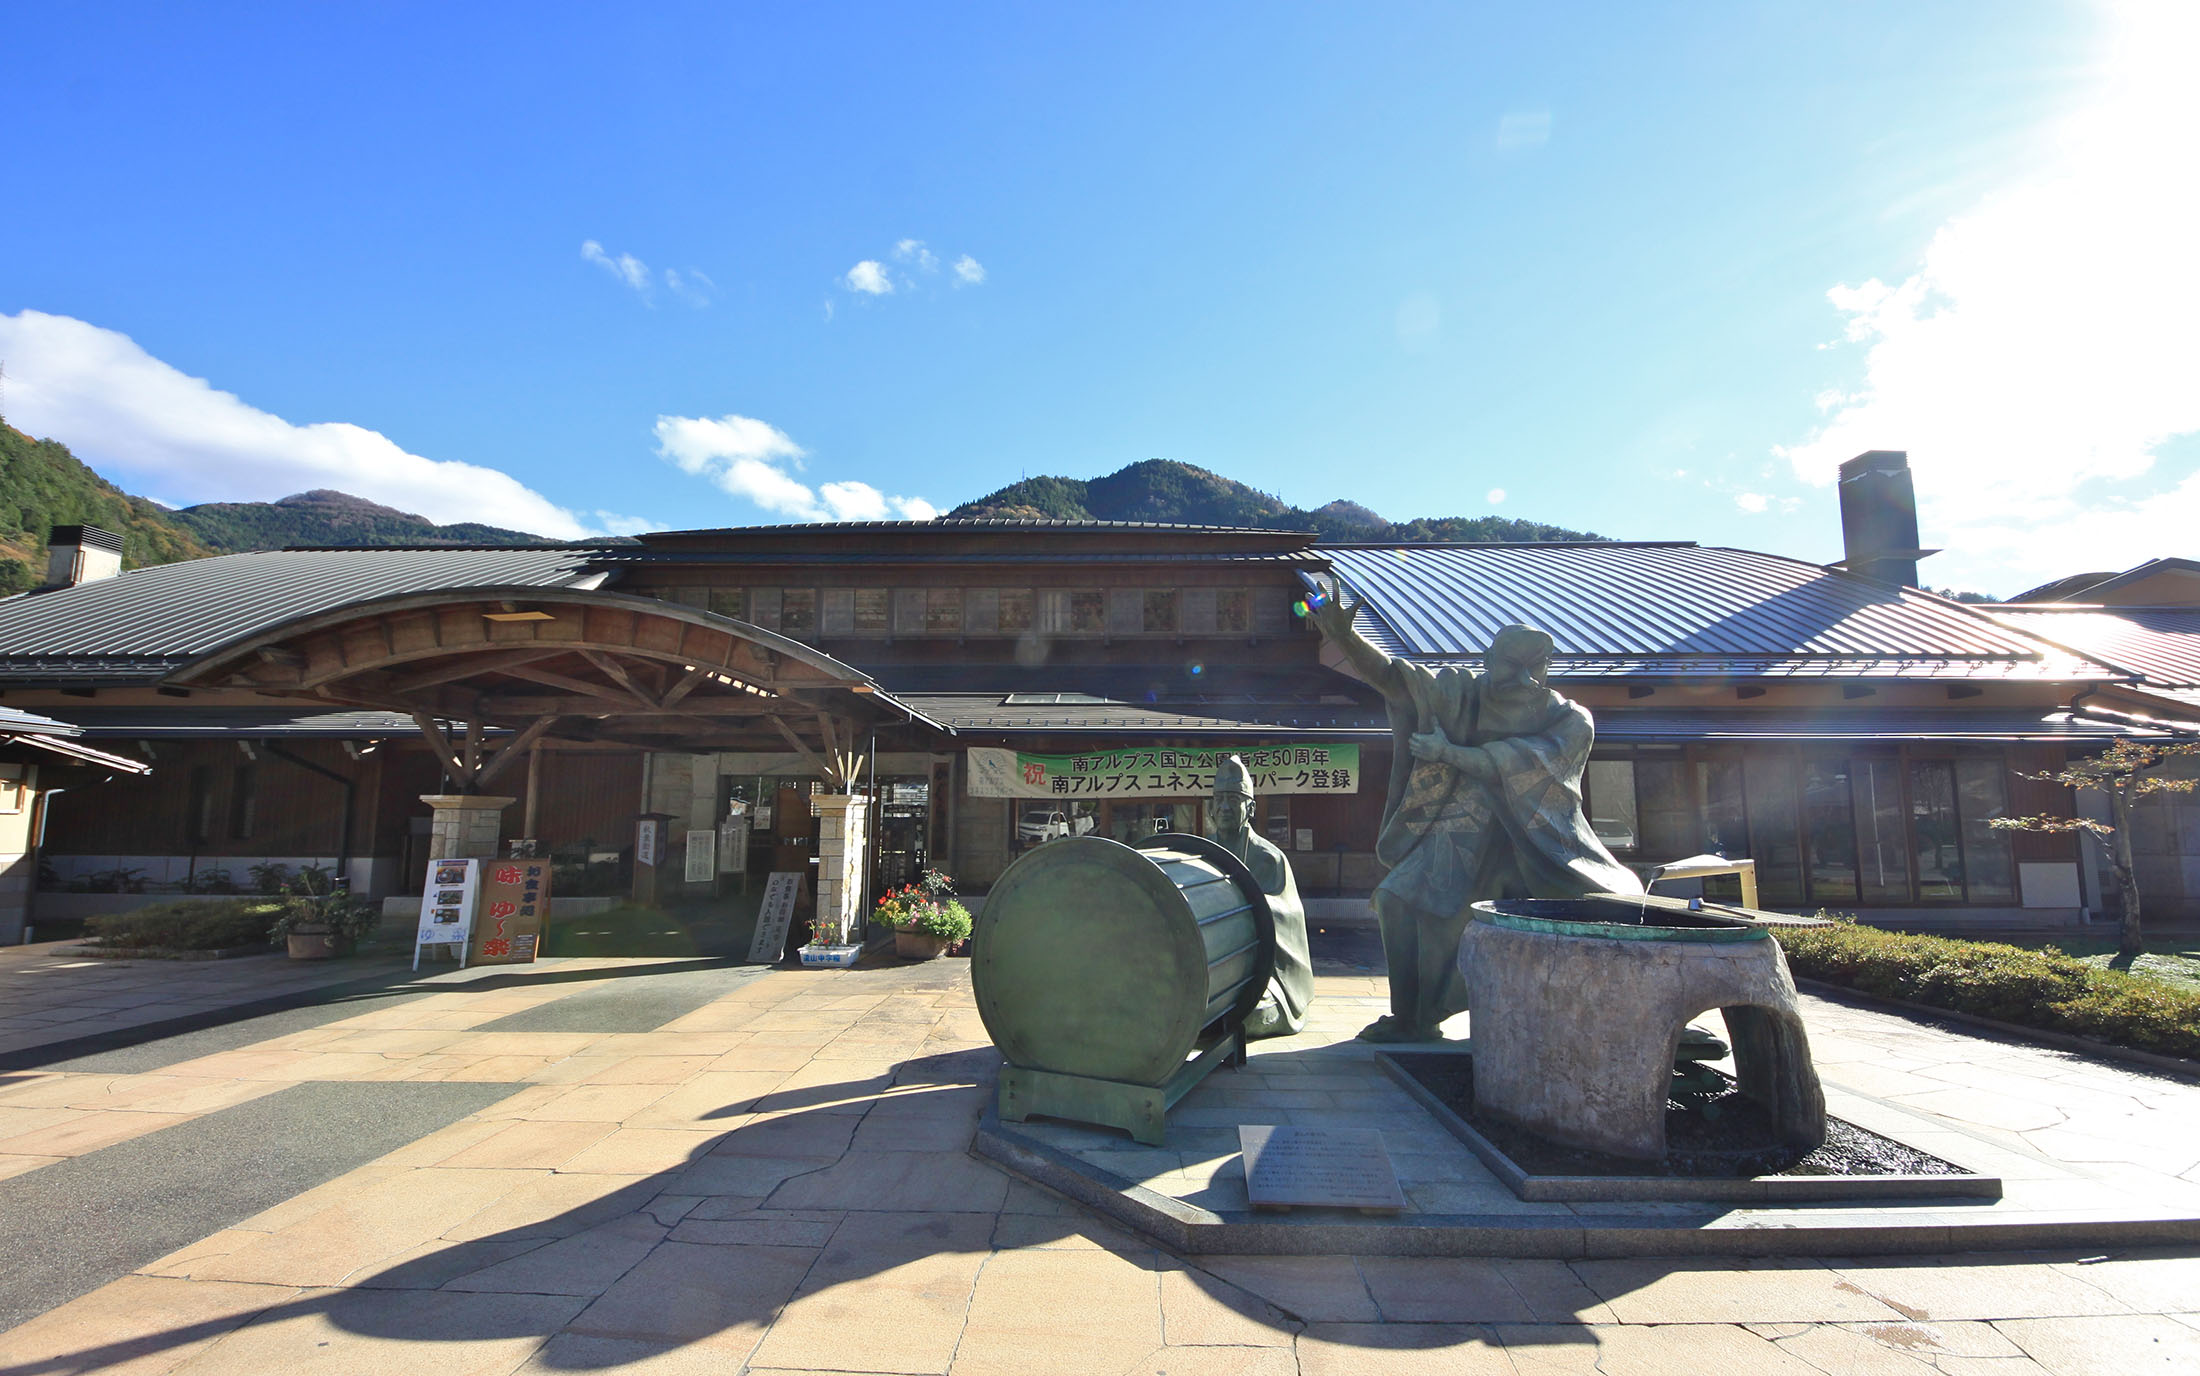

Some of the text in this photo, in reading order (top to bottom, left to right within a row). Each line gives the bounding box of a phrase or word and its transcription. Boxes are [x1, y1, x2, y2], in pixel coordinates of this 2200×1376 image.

[1023, 762, 1046, 785] 祝
[1051, 769, 1351, 793] 南アルプス ユネスコパーク登録
[495, 865, 523, 885] 味
